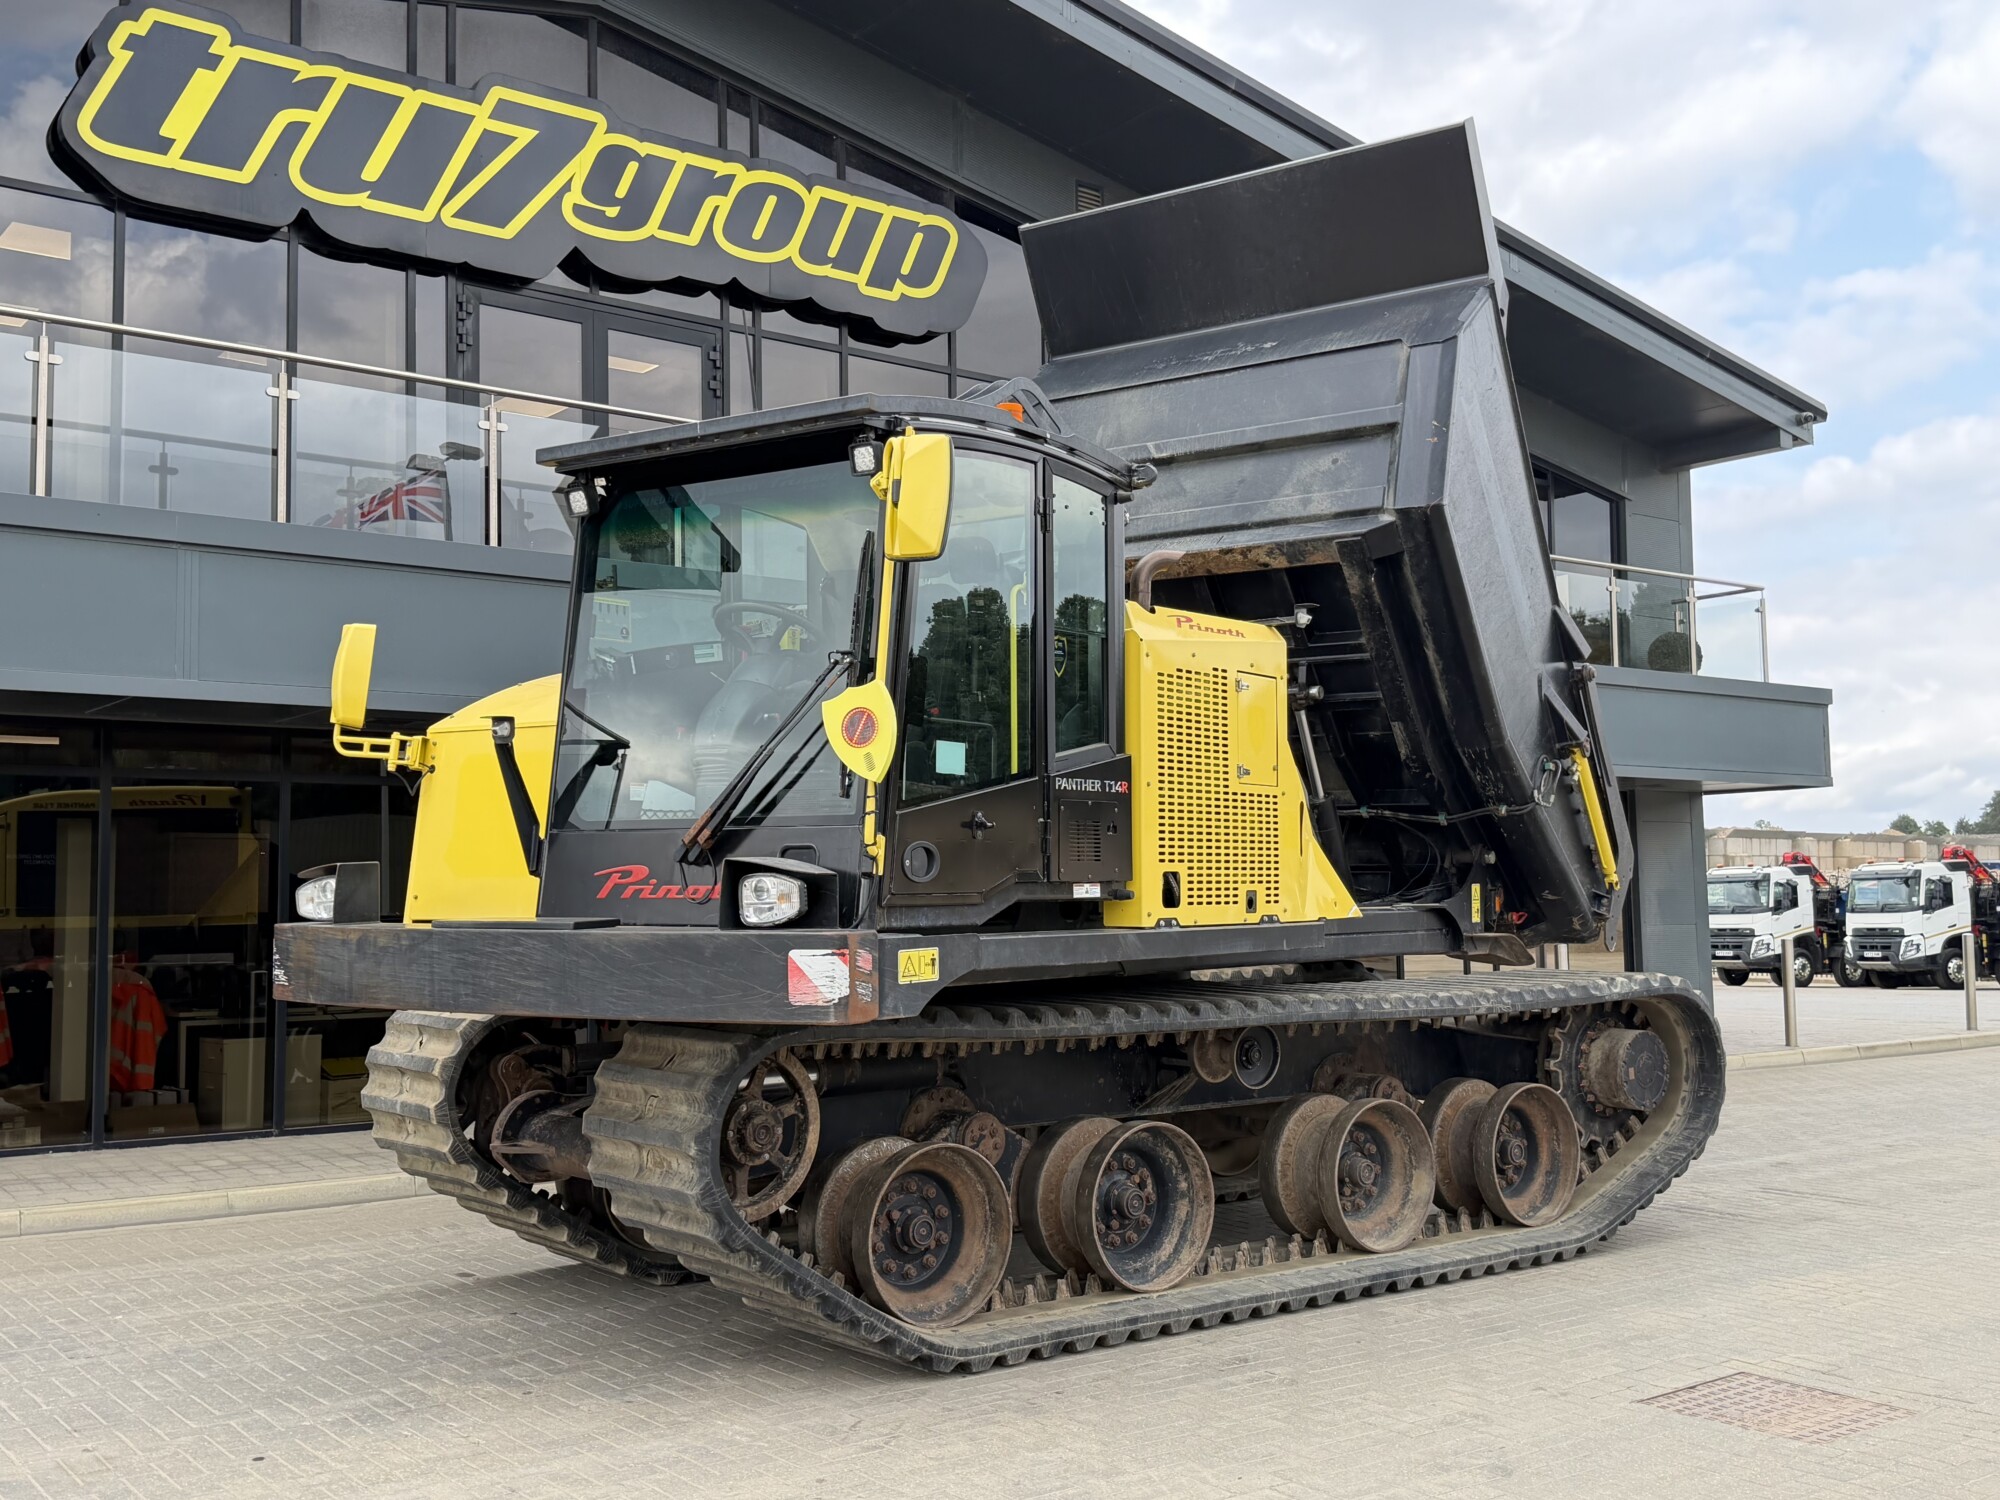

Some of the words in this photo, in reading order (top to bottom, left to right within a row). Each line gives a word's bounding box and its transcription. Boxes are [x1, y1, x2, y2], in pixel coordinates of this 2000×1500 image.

[1167, 614, 1246, 638] Prinoth
[1055, 777, 1101, 792] PANTHER
[1104, 780, 1129, 793] T14R
[593, 864, 722, 900] Prinot
